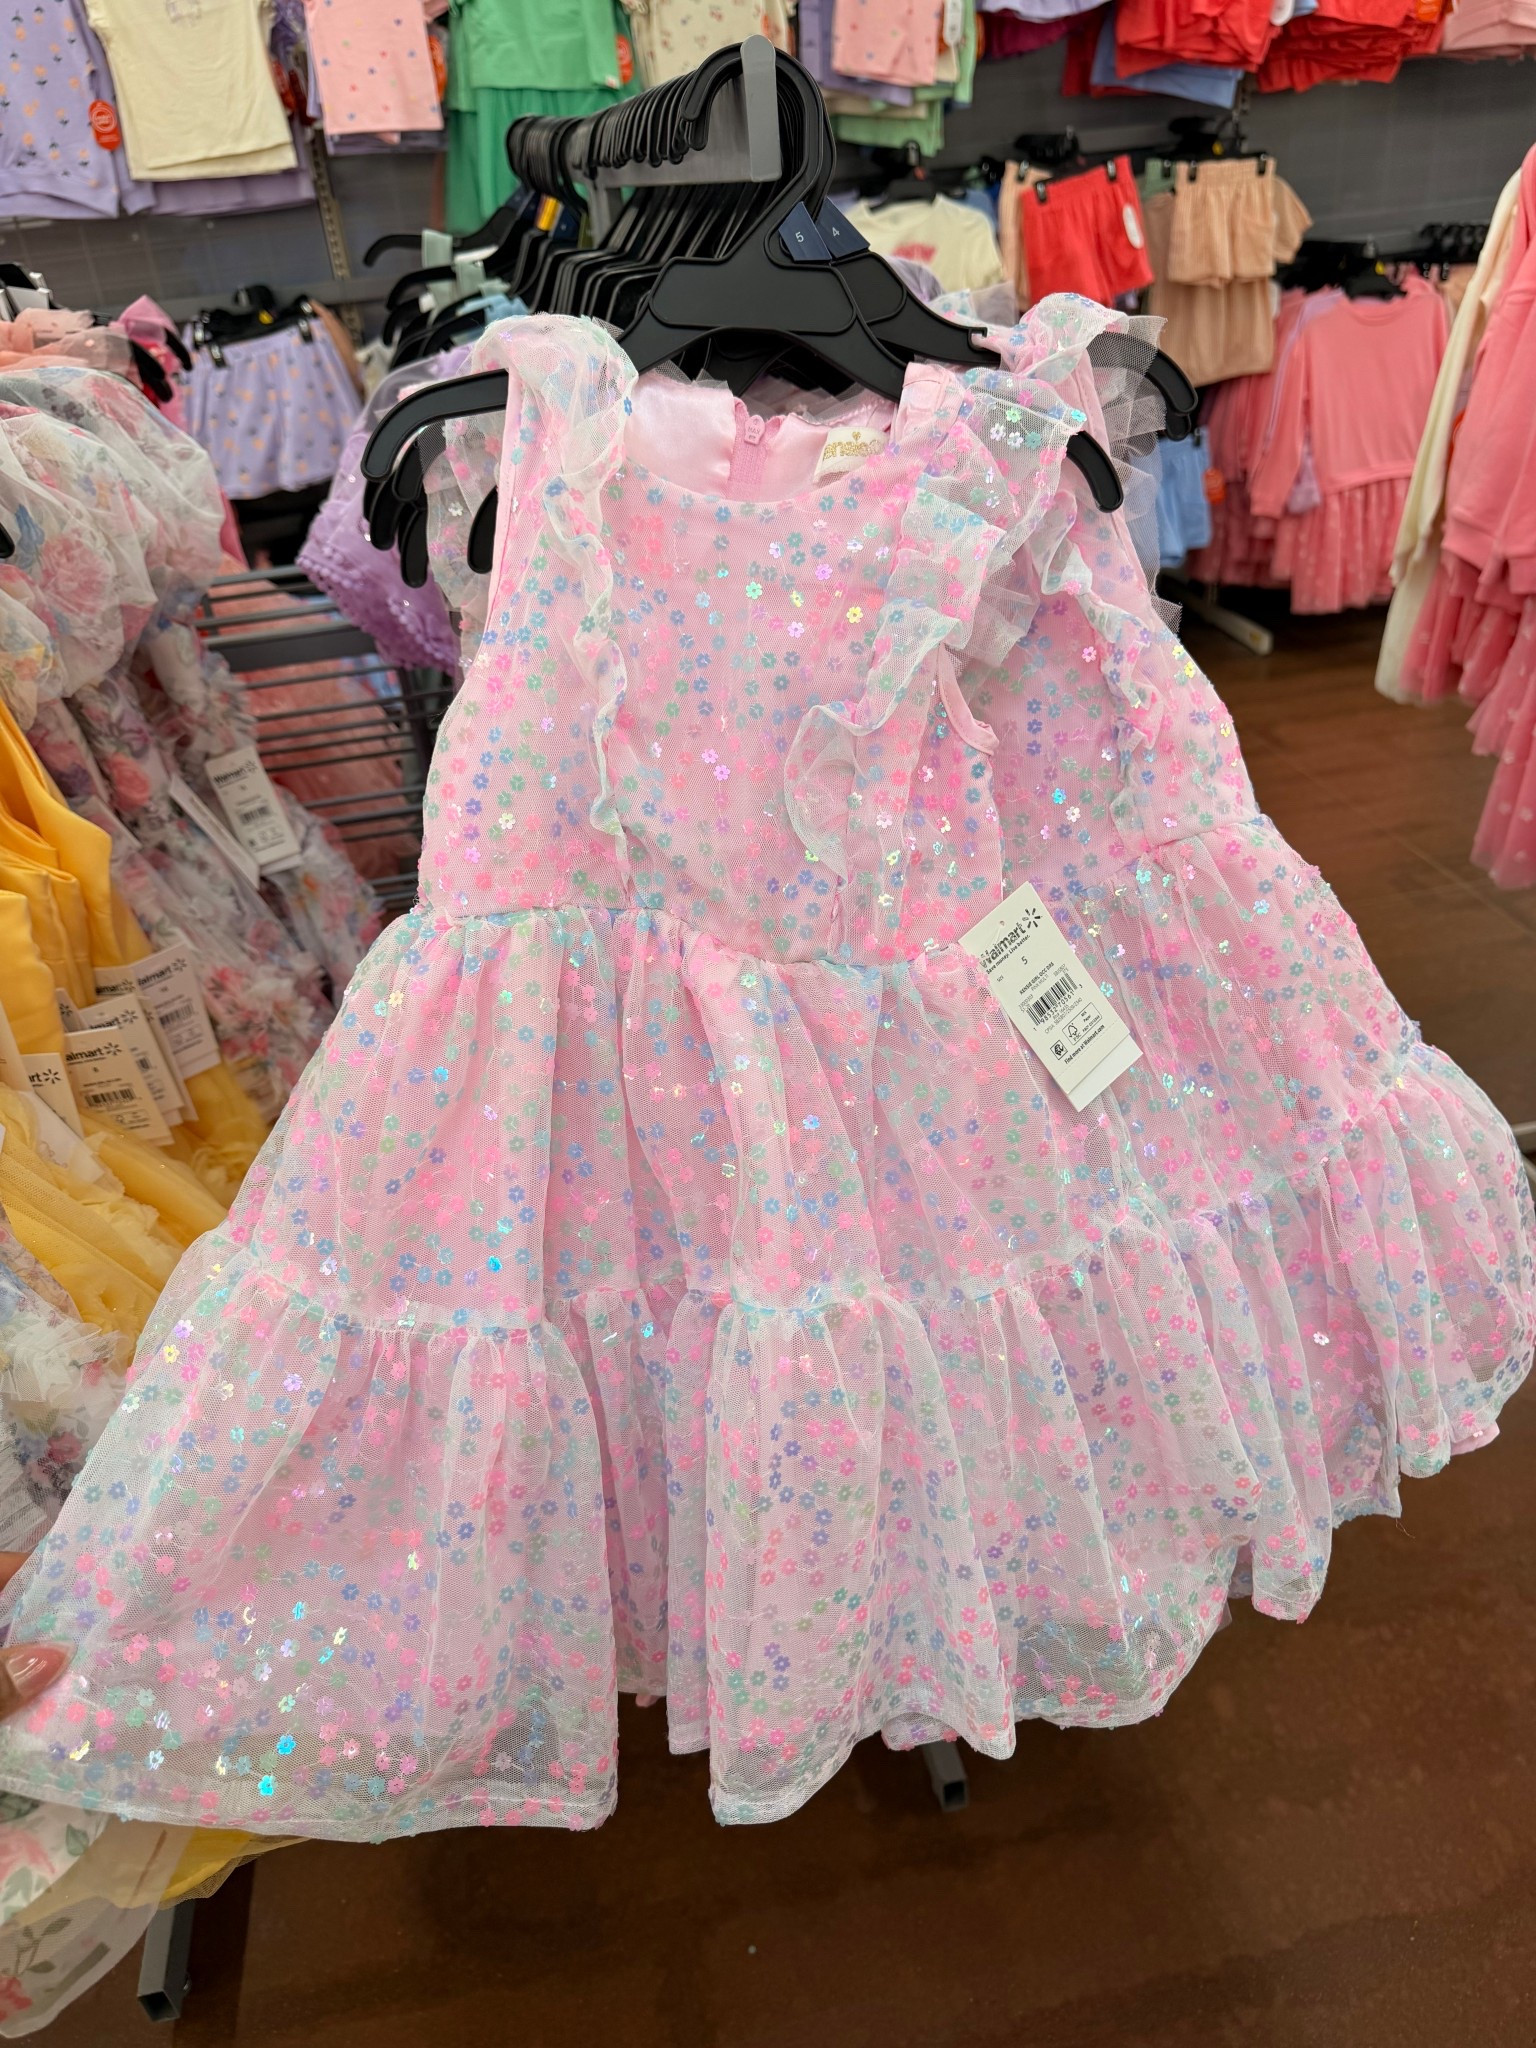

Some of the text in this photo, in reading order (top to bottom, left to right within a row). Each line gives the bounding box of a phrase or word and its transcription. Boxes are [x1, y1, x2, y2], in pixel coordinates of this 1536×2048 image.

[795, 231, 804, 243] 5
[832, 226, 840, 237] 4
[979, 922, 1026, 968] Walmart
[985, 934, 1030, 974] Save money. Live better.
[1020, 955, 1027, 965] 5
[1040, 1007, 1058, 1023] 98532
[1057, 990, 1074, 1007] 70561
[65, 1048, 104, 1061] almart
[1063, 1054, 1073, 1064] Find
[1071, 1047, 1081, 1057] more
[1082, 1024, 1104, 1045] Walmart.com
